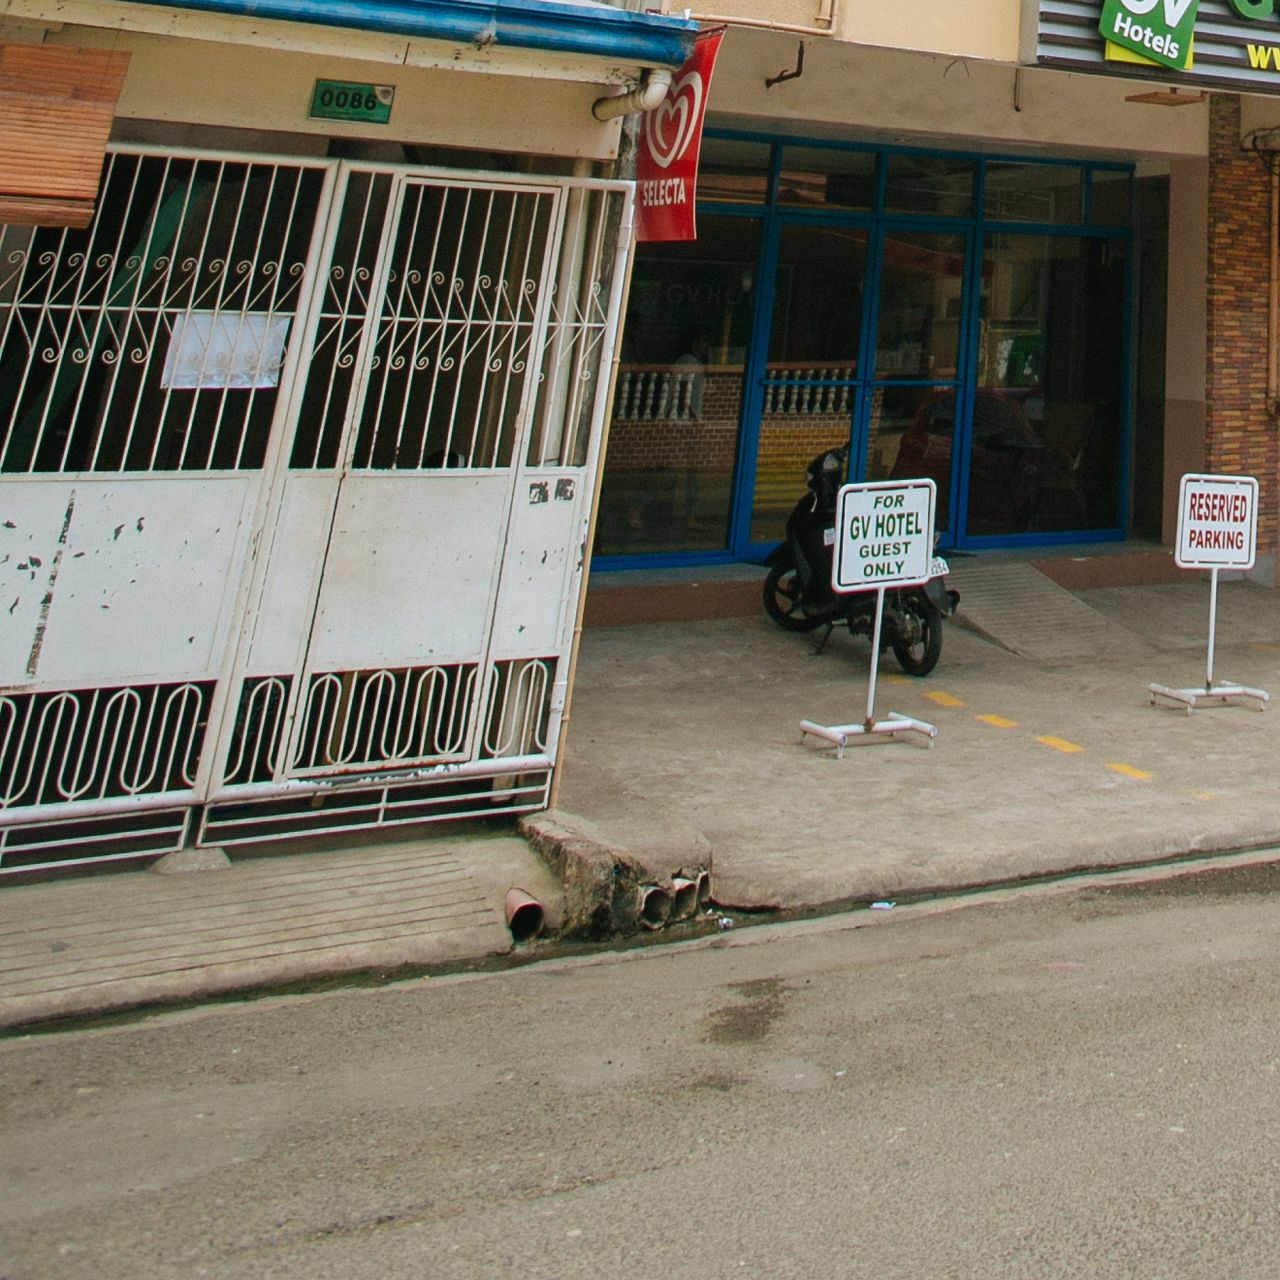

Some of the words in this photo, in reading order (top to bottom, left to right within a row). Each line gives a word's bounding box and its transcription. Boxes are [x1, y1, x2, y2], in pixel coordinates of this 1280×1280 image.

[1113, 12, 1180, 59] Hotels
[321, 90, 377, 111] 0086
[642, 178, 686, 207] SELECTA
[873, 494, 905, 509] FOR
[1189, 493, 1247, 523] RESERVED
[850, 515, 871, 540] GV
[875, 511, 922, 538] HOTEL
[859, 541, 911, 558] GUEST
[1189, 529, 1244, 550] PARKING
[863, 561, 905, 577] ONLY
